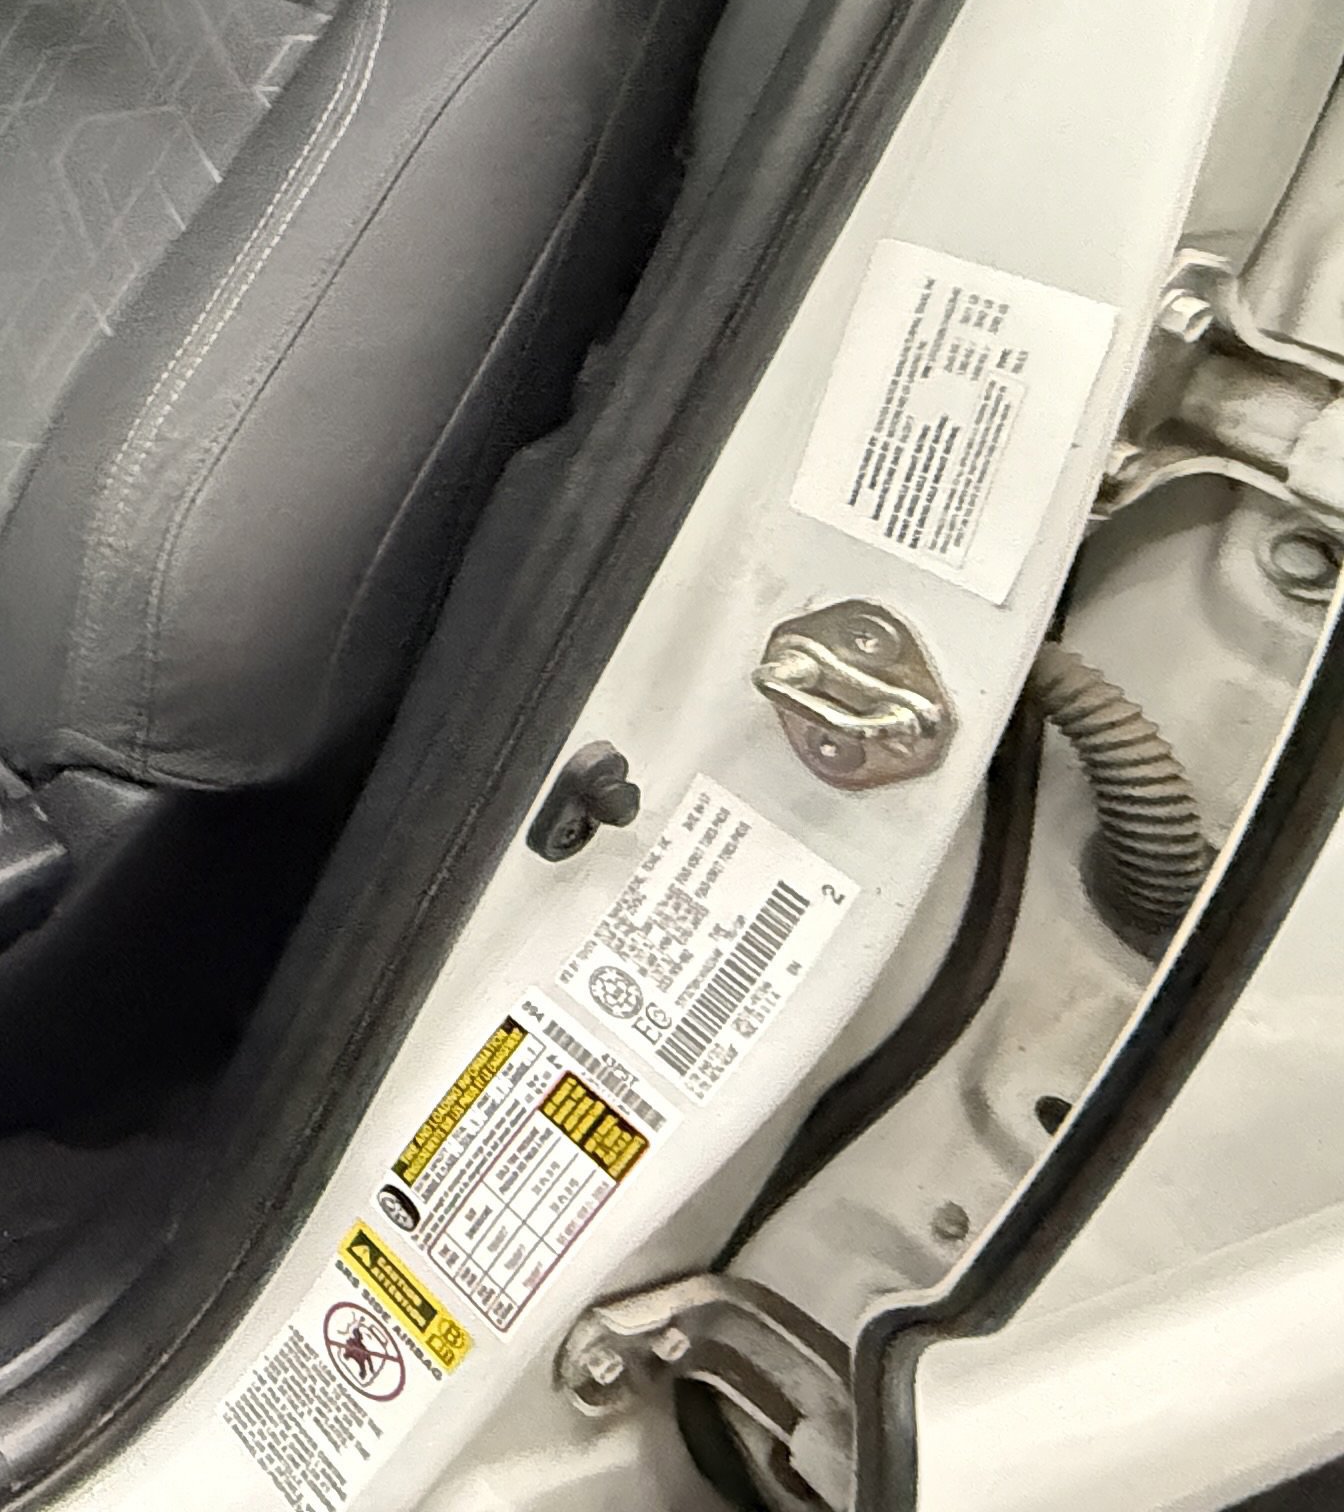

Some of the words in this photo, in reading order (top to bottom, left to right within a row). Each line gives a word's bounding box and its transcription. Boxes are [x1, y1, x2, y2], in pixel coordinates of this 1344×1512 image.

[822, 883, 846, 905] 2
[414, 1123, 434, 1147] AND
[335, 1259, 361, 1289] SRS
[360, 1288, 391, 1322] SIDE
[393, 1324, 443, 1381] AIRBAG
